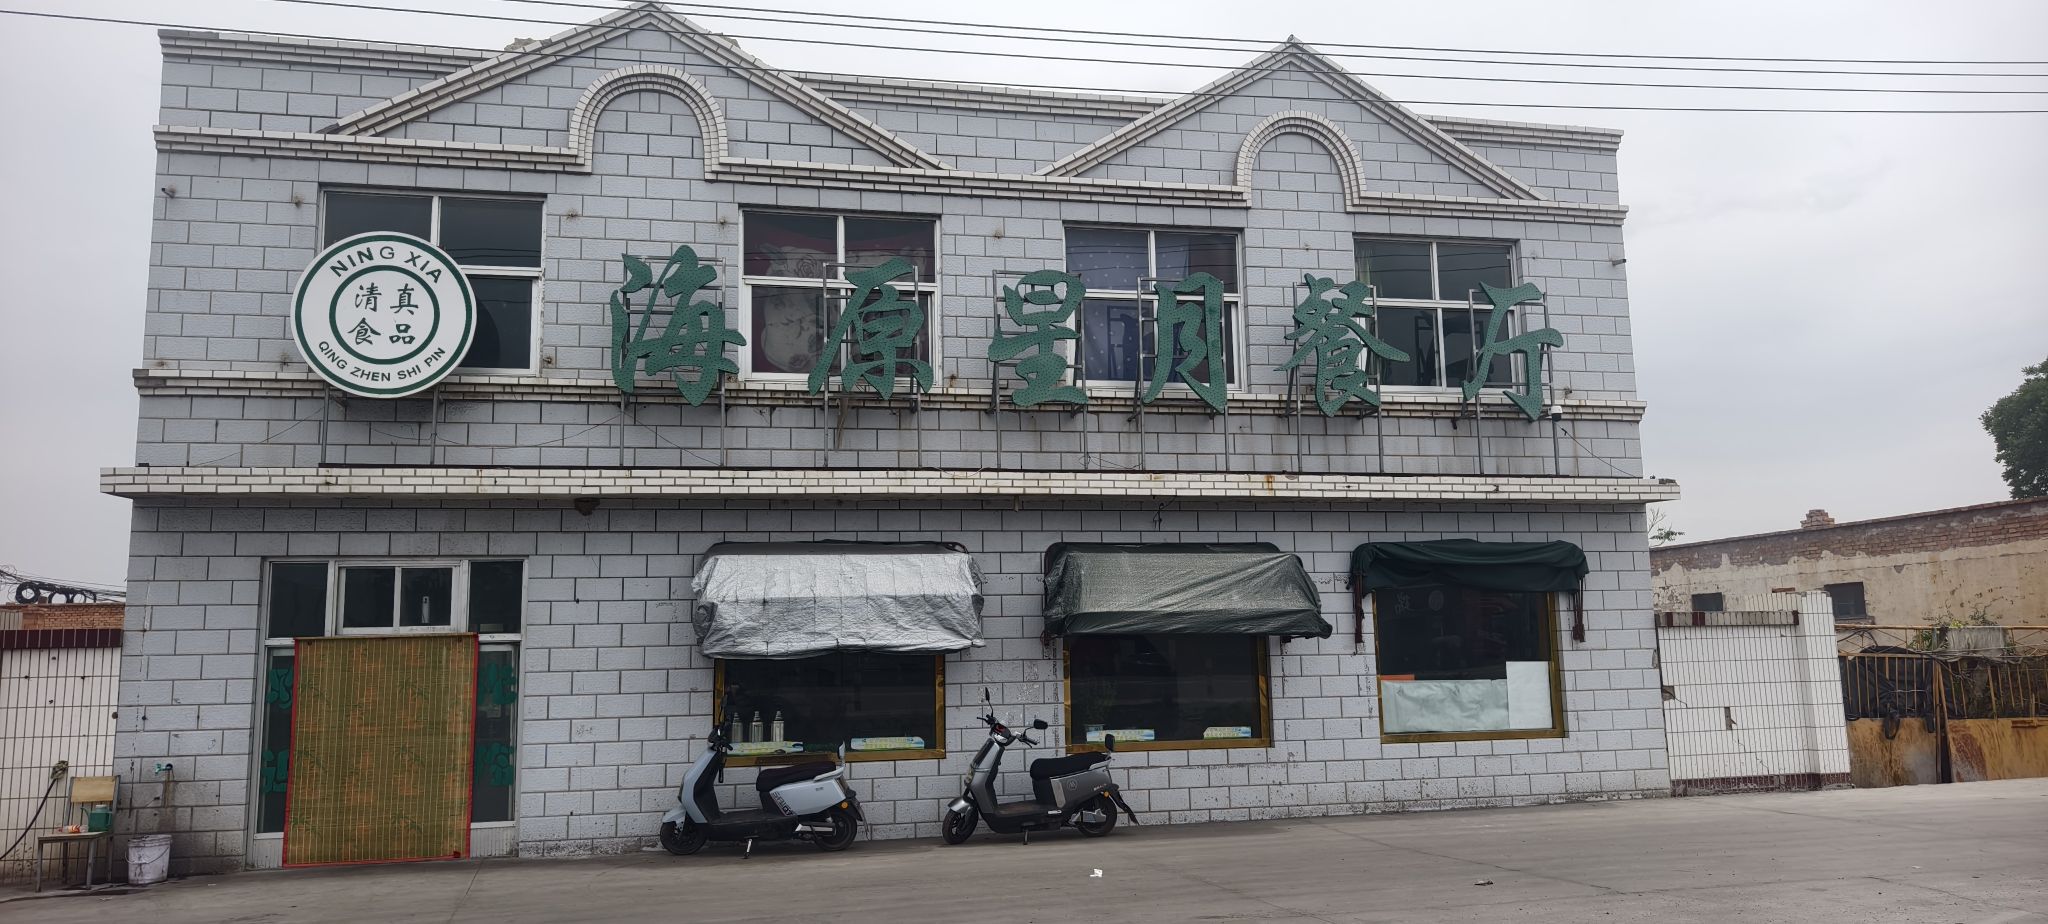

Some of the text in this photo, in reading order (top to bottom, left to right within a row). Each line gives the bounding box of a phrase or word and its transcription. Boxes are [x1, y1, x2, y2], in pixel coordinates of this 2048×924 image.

[329, 246, 442, 284] NING XIA
[354, 282, 419, 315] 清真
[347, 317, 416, 345] 食品
[610, 244, 1564, 422] 海原星月餐厅
[318, 341, 446, 382] QING ZHEN SHI PIN
